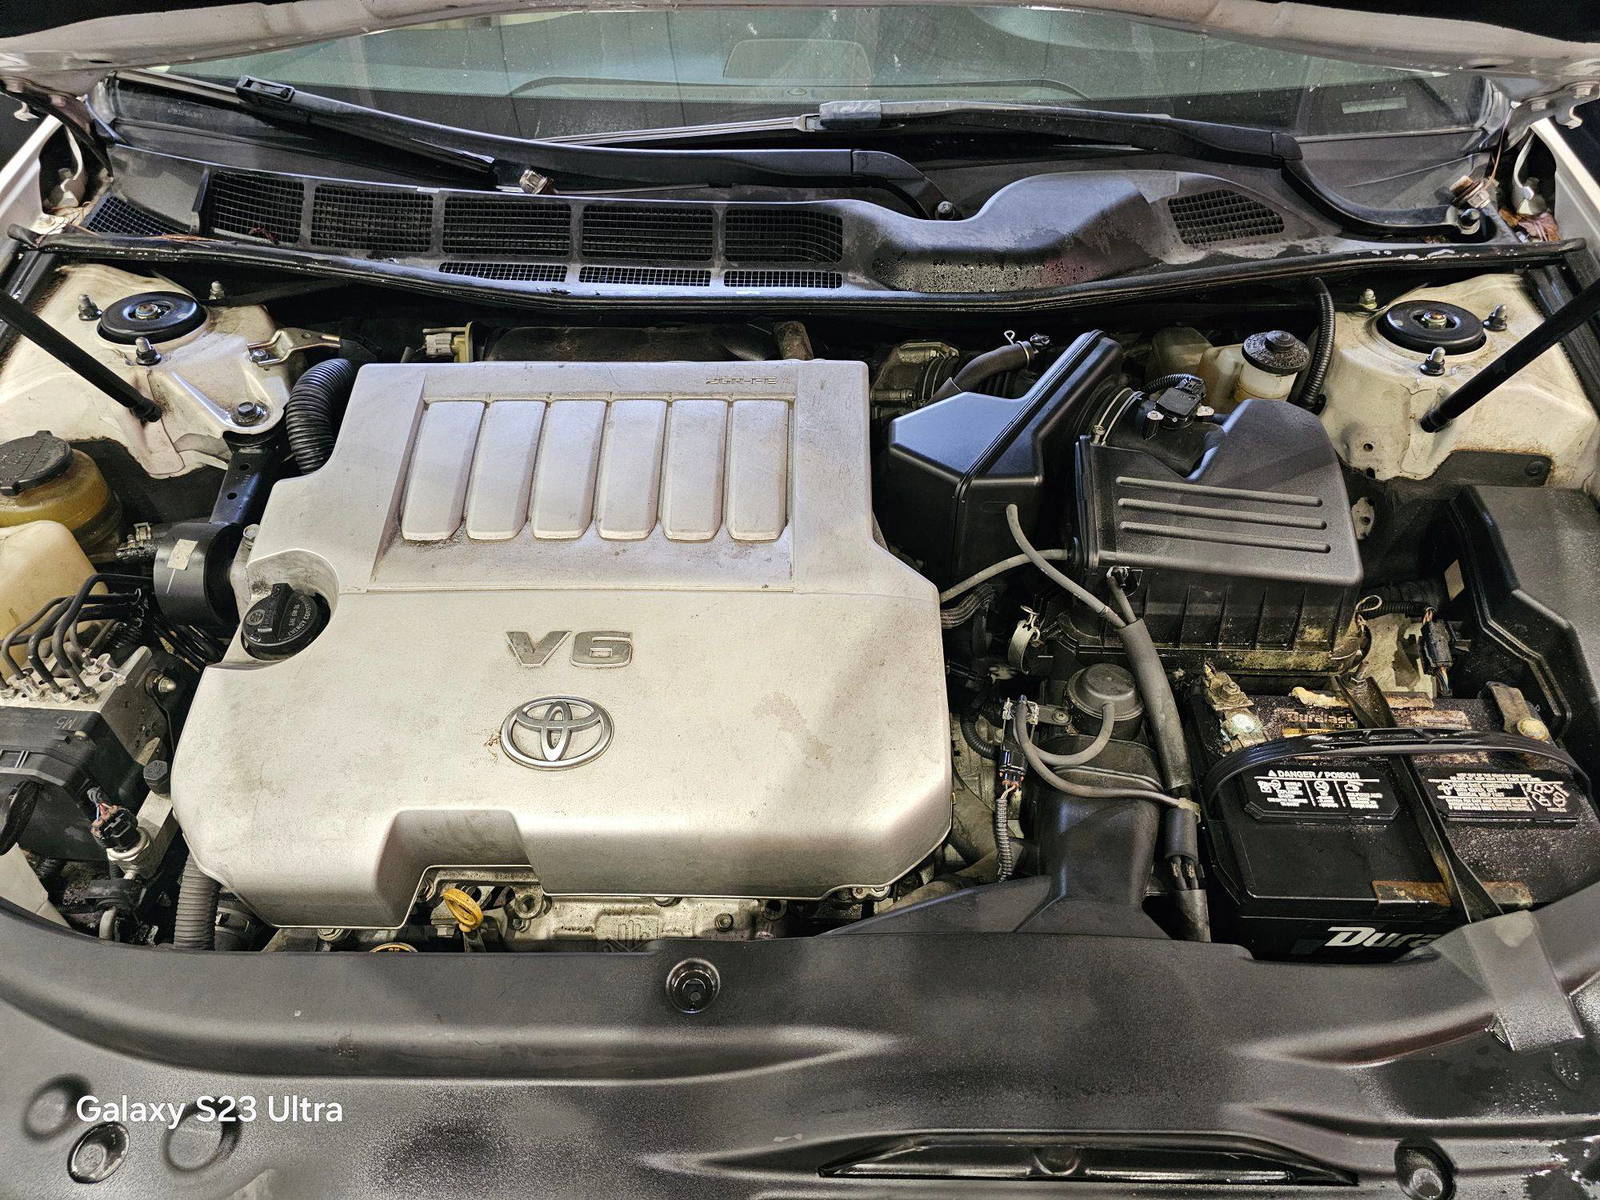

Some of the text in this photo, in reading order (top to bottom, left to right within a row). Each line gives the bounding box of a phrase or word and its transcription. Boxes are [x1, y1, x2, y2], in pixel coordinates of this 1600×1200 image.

[505, 630, 633, 669] V6
[1277, 770, 1316, 778] DANGER
[1324, 771, 1360, 779] POISON
